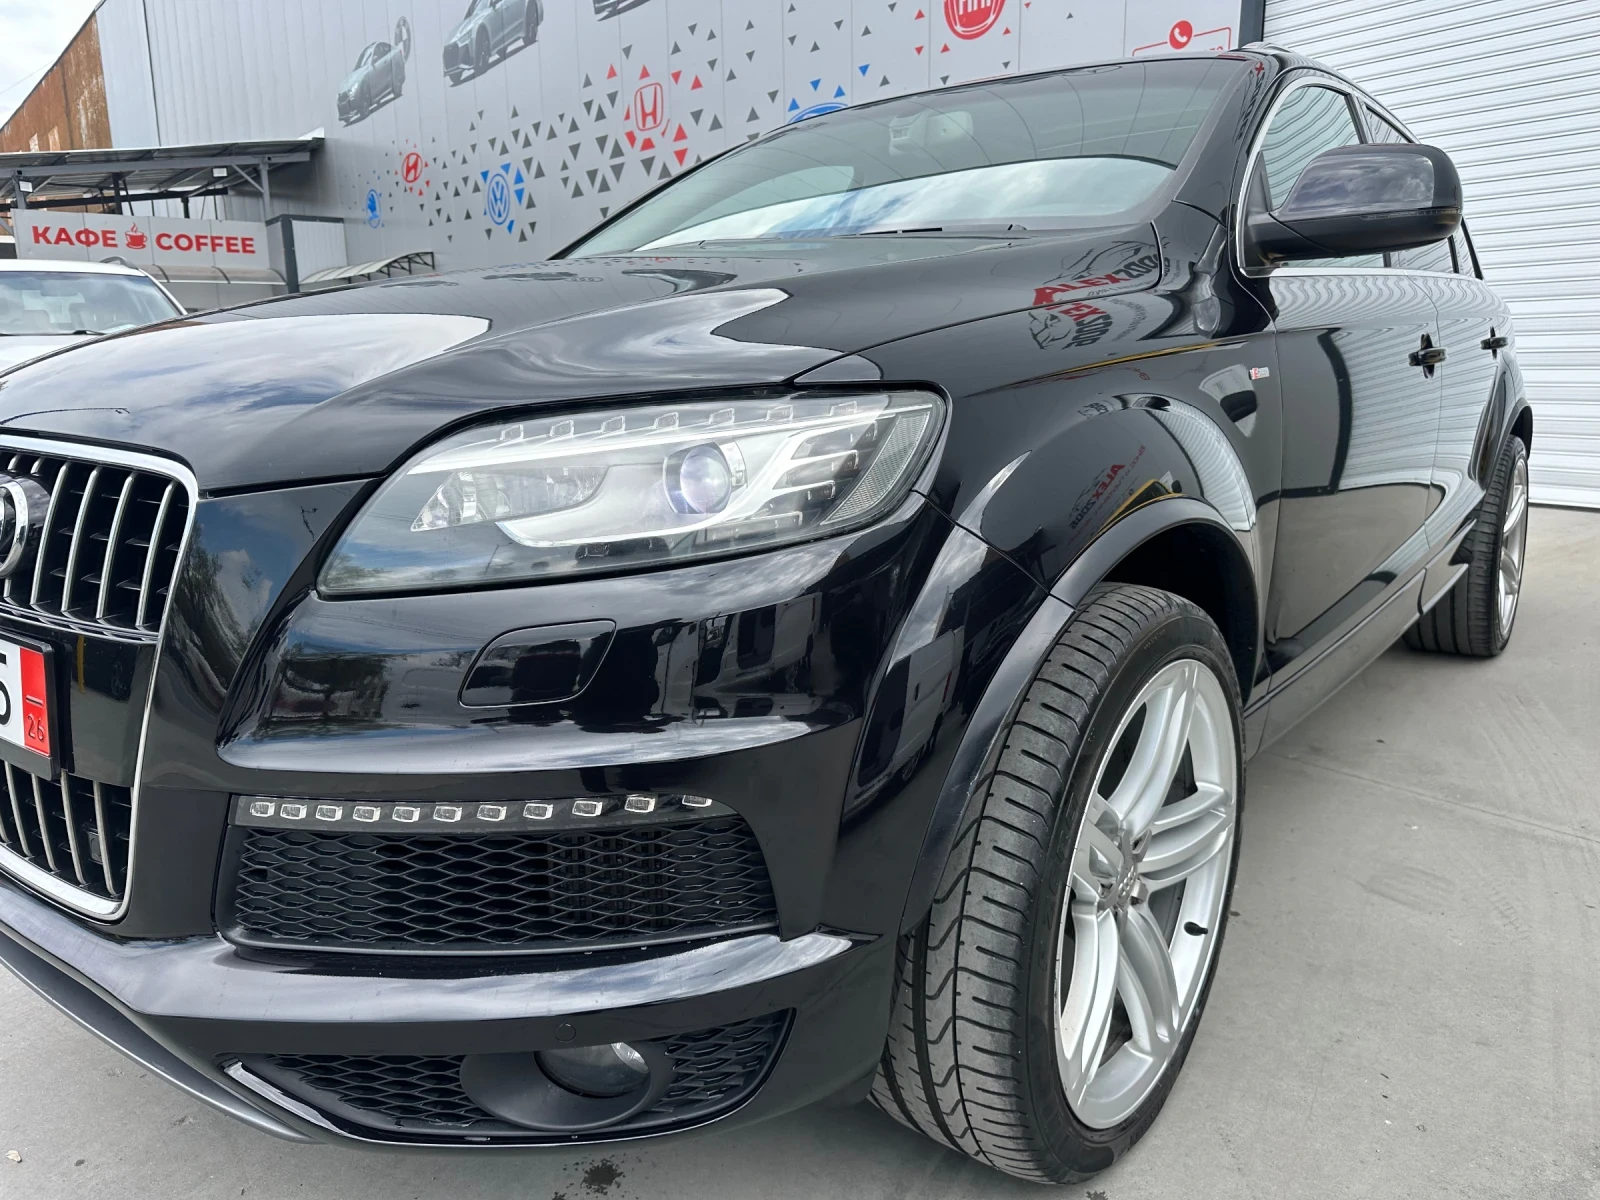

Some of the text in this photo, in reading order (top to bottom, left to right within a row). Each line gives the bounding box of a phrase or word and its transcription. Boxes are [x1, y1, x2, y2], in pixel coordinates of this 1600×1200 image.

[32, 225, 118, 248] КАФЕ
[155, 232, 256, 254] COFFEE
[28, 713, 45, 742] 26
